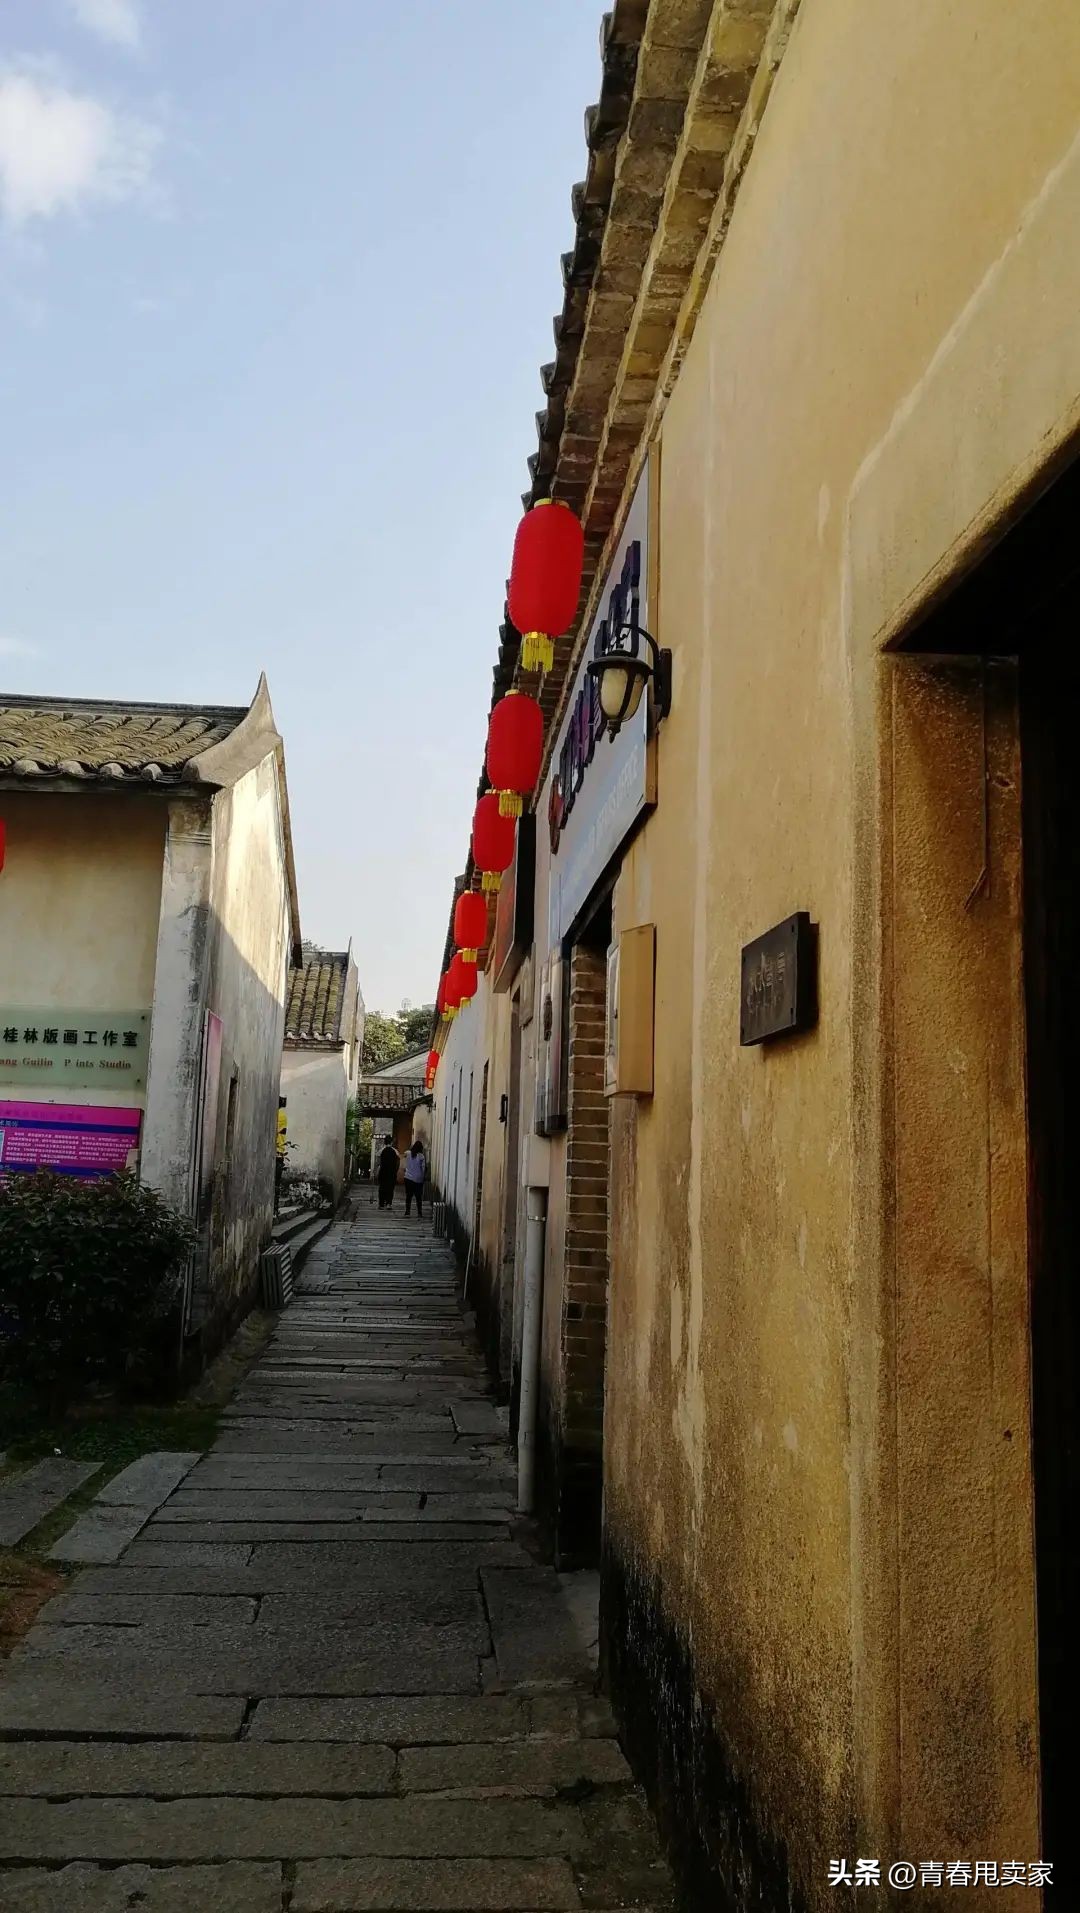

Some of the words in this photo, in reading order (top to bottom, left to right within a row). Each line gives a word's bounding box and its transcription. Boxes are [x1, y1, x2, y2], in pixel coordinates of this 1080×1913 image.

[3, 1027, 138, 1047] 桂林版画工作室
[22, 1057, 53, 1067] Guilin
[99, 1060, 132, 1069] Studio
